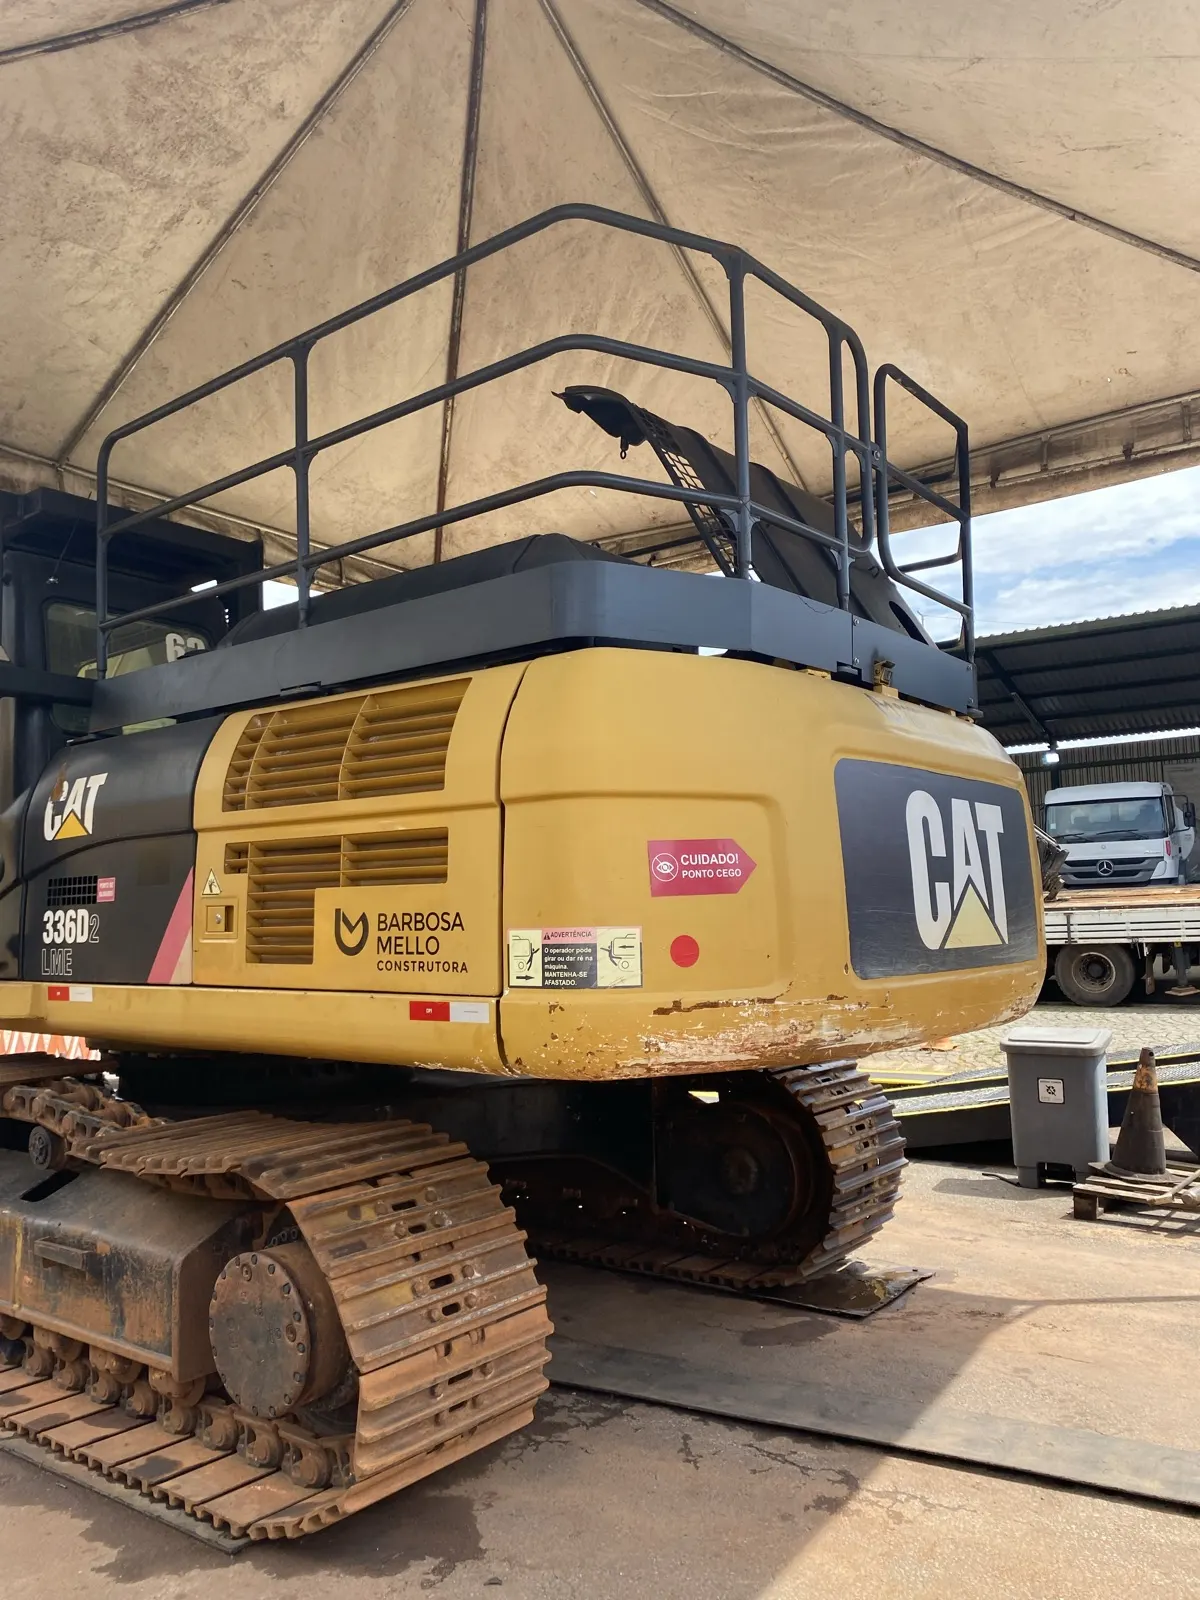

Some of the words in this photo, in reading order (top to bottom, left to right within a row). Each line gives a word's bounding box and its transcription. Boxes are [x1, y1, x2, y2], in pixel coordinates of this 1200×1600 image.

[44, 772, 108, 841] CAT
[680, 853, 739, 866] CUIDADO!
[905, 789, 1009, 950] CAT
[681, 869, 715, 879] PONTO
[716, 868, 742, 878] CEGO
[377, 911, 465, 931] BARBOSA
[376, 935, 440, 956] MELLO
[41, 948, 73, 976] LME
[376, 960, 468, 974] CONSTRUTORA
